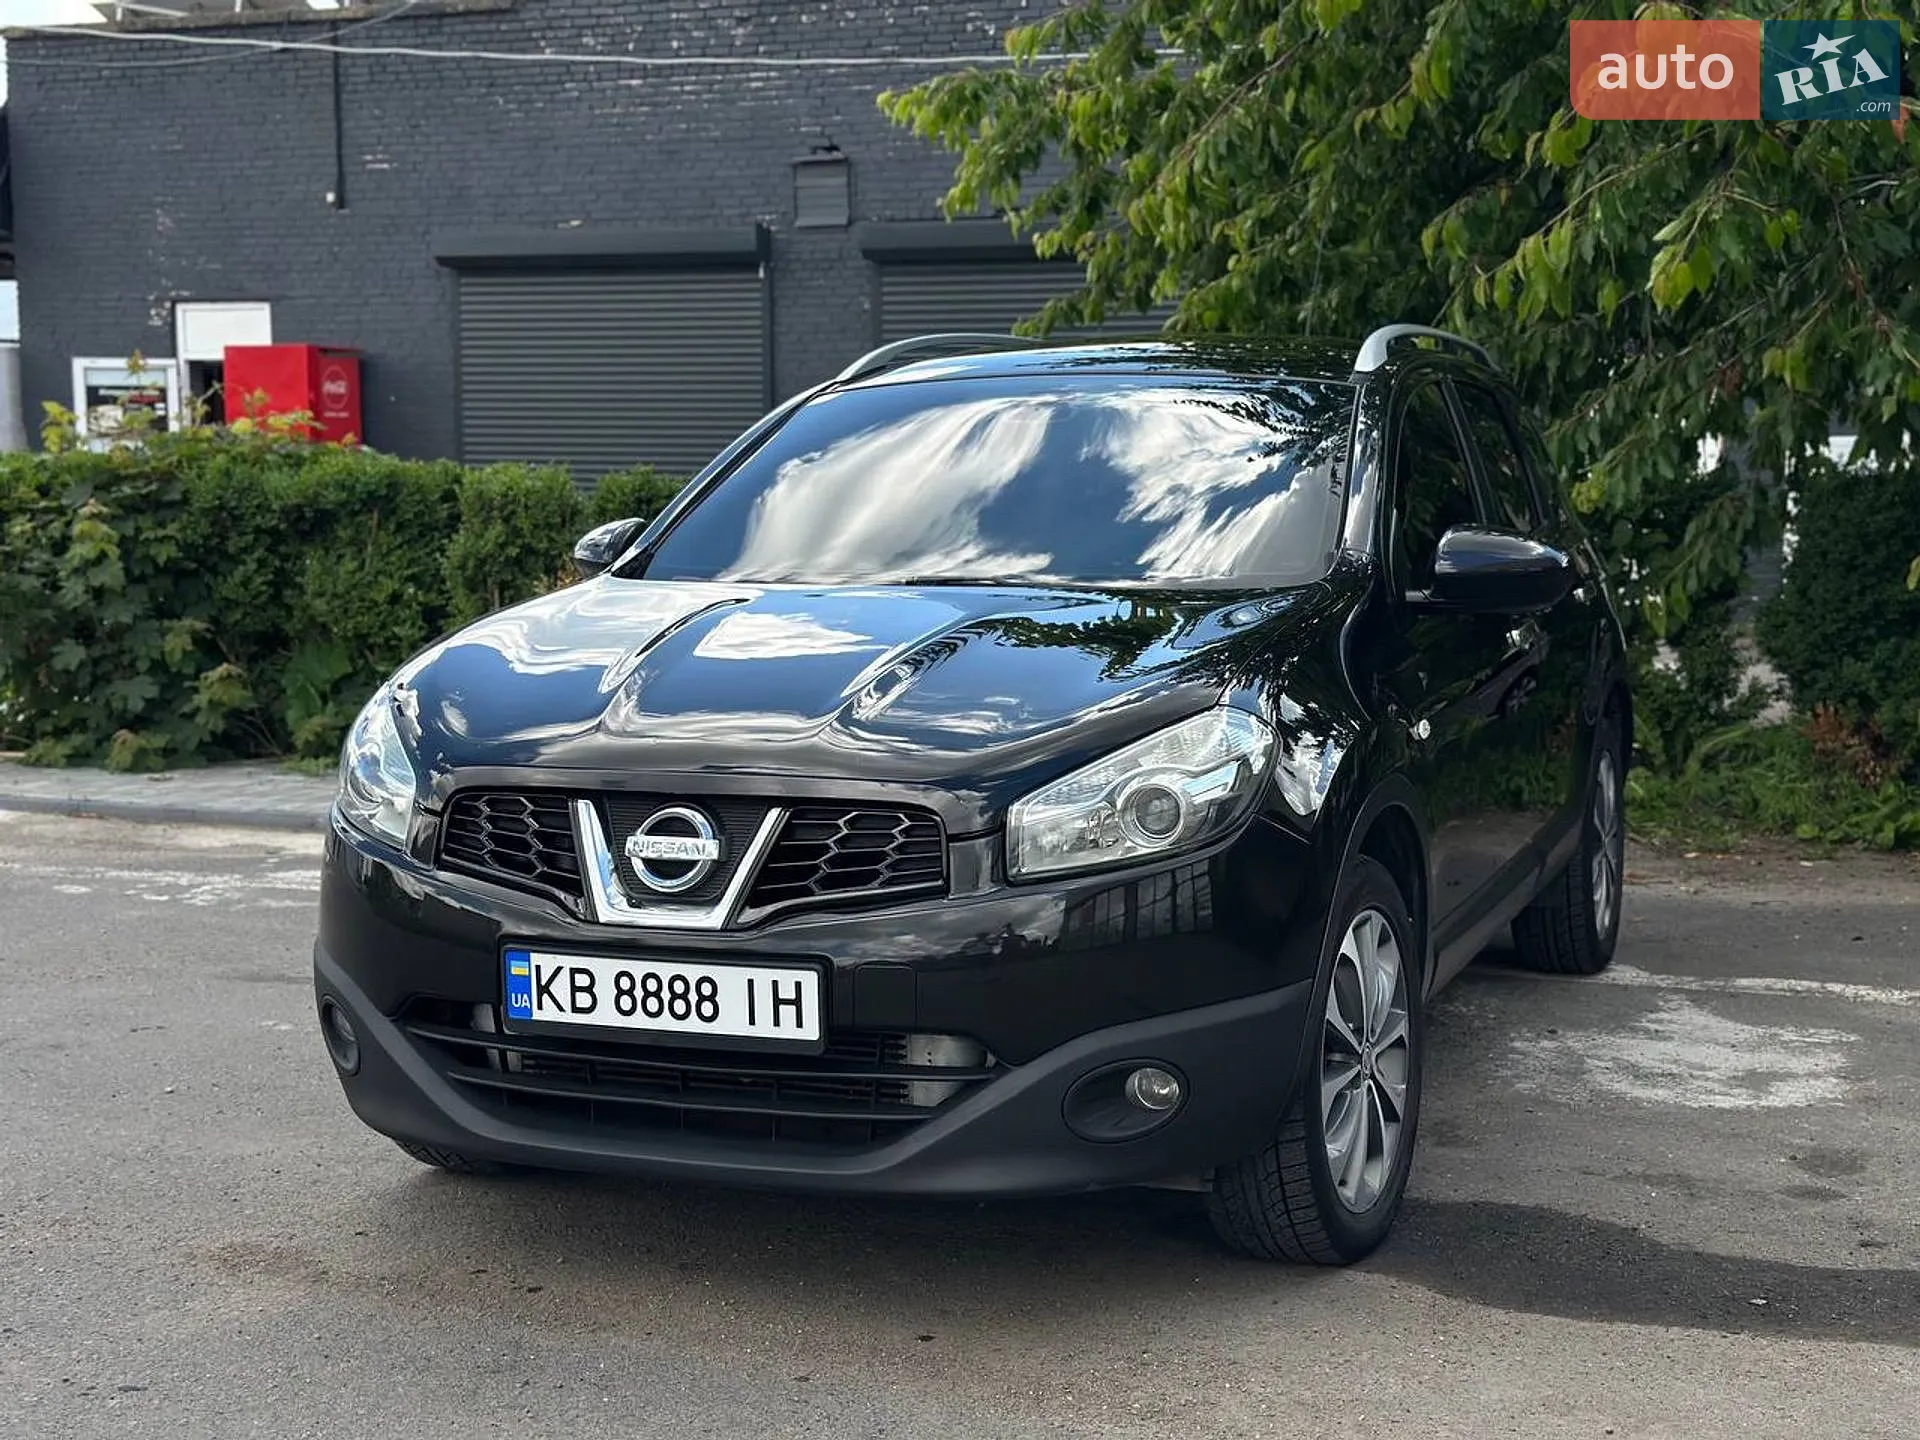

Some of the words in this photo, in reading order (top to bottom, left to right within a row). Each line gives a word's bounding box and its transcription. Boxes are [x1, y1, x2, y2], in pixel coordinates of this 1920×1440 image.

[633, 840, 707, 857] NISSAN
[511, 993, 531, 1009] UA
[535, 964, 598, 1015] KB
[613, 970, 720, 1023] 8888
[747, 978, 803, 1029] IH
